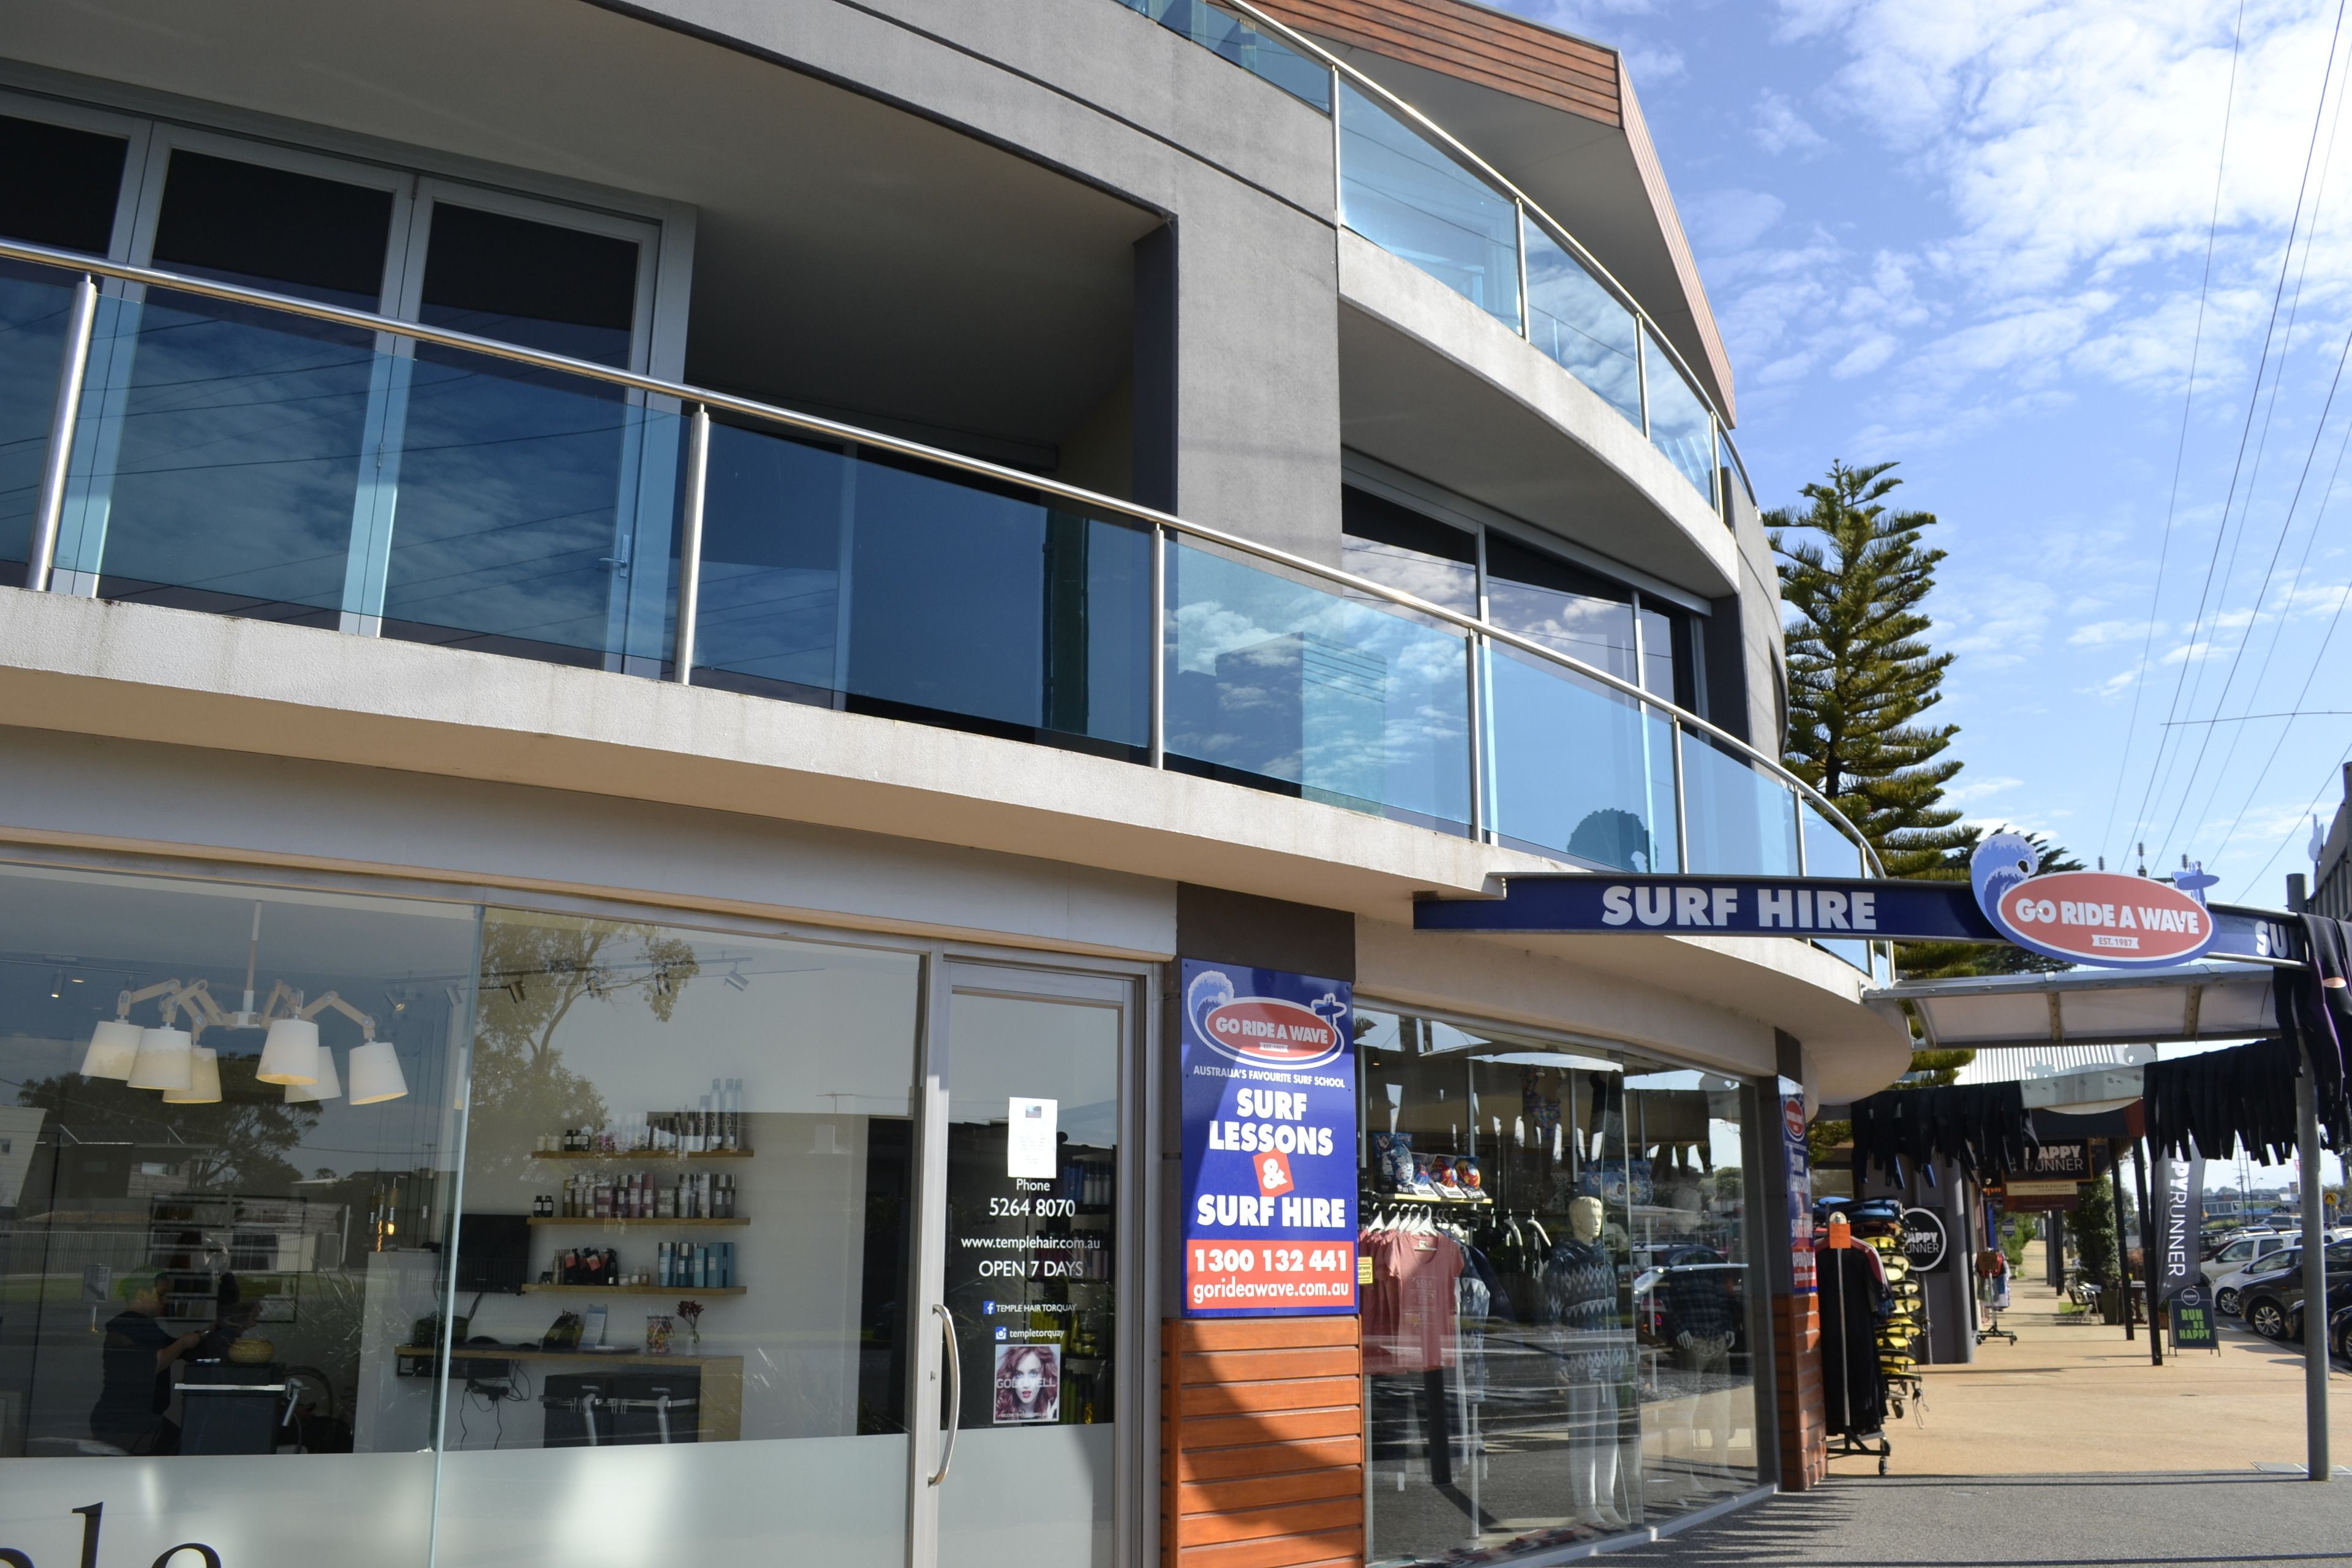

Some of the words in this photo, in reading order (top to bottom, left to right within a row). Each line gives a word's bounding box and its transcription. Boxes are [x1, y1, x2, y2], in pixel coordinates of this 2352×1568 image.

[1602, 886, 1738, 926] SURF
[1757, 889, 1877, 930] HIRE
[2015, 898, 2057, 924] GO
[2060, 900, 2116, 928] RIDE
[2119, 905, 2138, 929] A
[2138, 907, 2199, 935] WAVE
[2098, 937, 2113, 946] EST.
[2115, 938, 2133, 947] 1987
[2255, 921, 2304, 960] SU
[1215, 1017, 1240, 1034] GO
[1242, 1020, 1275, 1039] RIDE
[1276, 1024, 1289, 1040] A
[1289, 1025, 1329, 1044] WAVE
[1193, 1065, 1247, 1079] AUSTRALIA'S
[1249, 1070, 1292, 1083] FAVOURITE
[1293, 1074, 1313, 1085] SURF
[1314, 1076, 1346, 1088] SCHOOL
[1236, 1087, 1308, 1121] SURF
[1208, 1120, 1334, 1156] LESSONS
[1016, 1178, 1051, 1191] Phone
[1262, 1158, 1289, 1189] &
[989, 1197, 1031, 1217] 5264
[1035, 1199, 1076, 1218] 8070
[1197, 1194, 1275, 1226] SURF
[1281, 1197, 1346, 1228] HIRE
[960, 1235, 1101, 1253] www.templehair.com.au
[979, 1261, 1025, 1277] OPEN
[1030, 1261, 1040, 1277] 7
[1044, 1261, 1084, 1277] DAYS
[1194, 1248, 1255, 1272] 1300
[1262, 1249, 1304, 1272] 132
[1308, 1250, 1347, 1272] 441
[1193, 1275, 1349, 1304] gorideawave.com.au
[996, 1304, 1022, 1313] TEMPLE
[1023, 1304, 1041, 1313] HAIR
[1042, 1303, 1077, 1313] TORQUAY
[2180, 1309, 2203, 1321] RUN
[1009, 1329, 1065, 1340] templetorquay
[2179, 1329, 2211, 1340] HAPPY
[2193, 1321, 2204, 1329] BE
[997, 1378, 1057, 1389] GOLDELL
